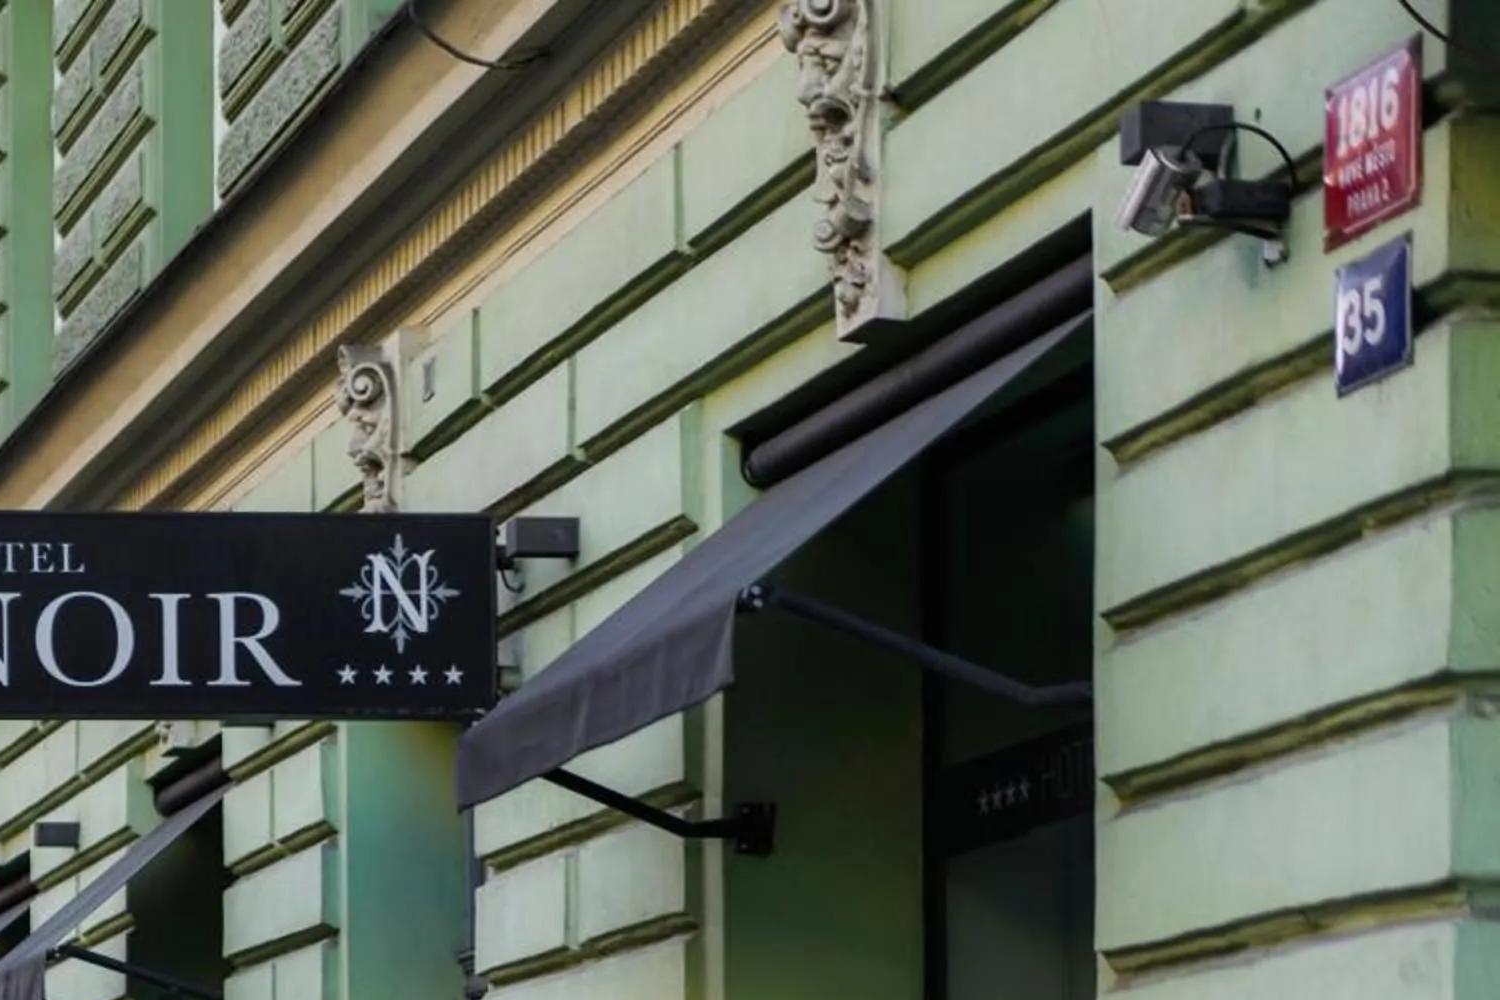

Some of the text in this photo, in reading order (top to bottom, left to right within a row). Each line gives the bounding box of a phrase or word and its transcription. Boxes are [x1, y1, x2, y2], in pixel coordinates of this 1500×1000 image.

[1335, 67, 1399, 158] 1816
[1381, 177, 1390, 202] 2
[1340, 276, 1386, 355] 35
[366, 548, 437, 634] N
